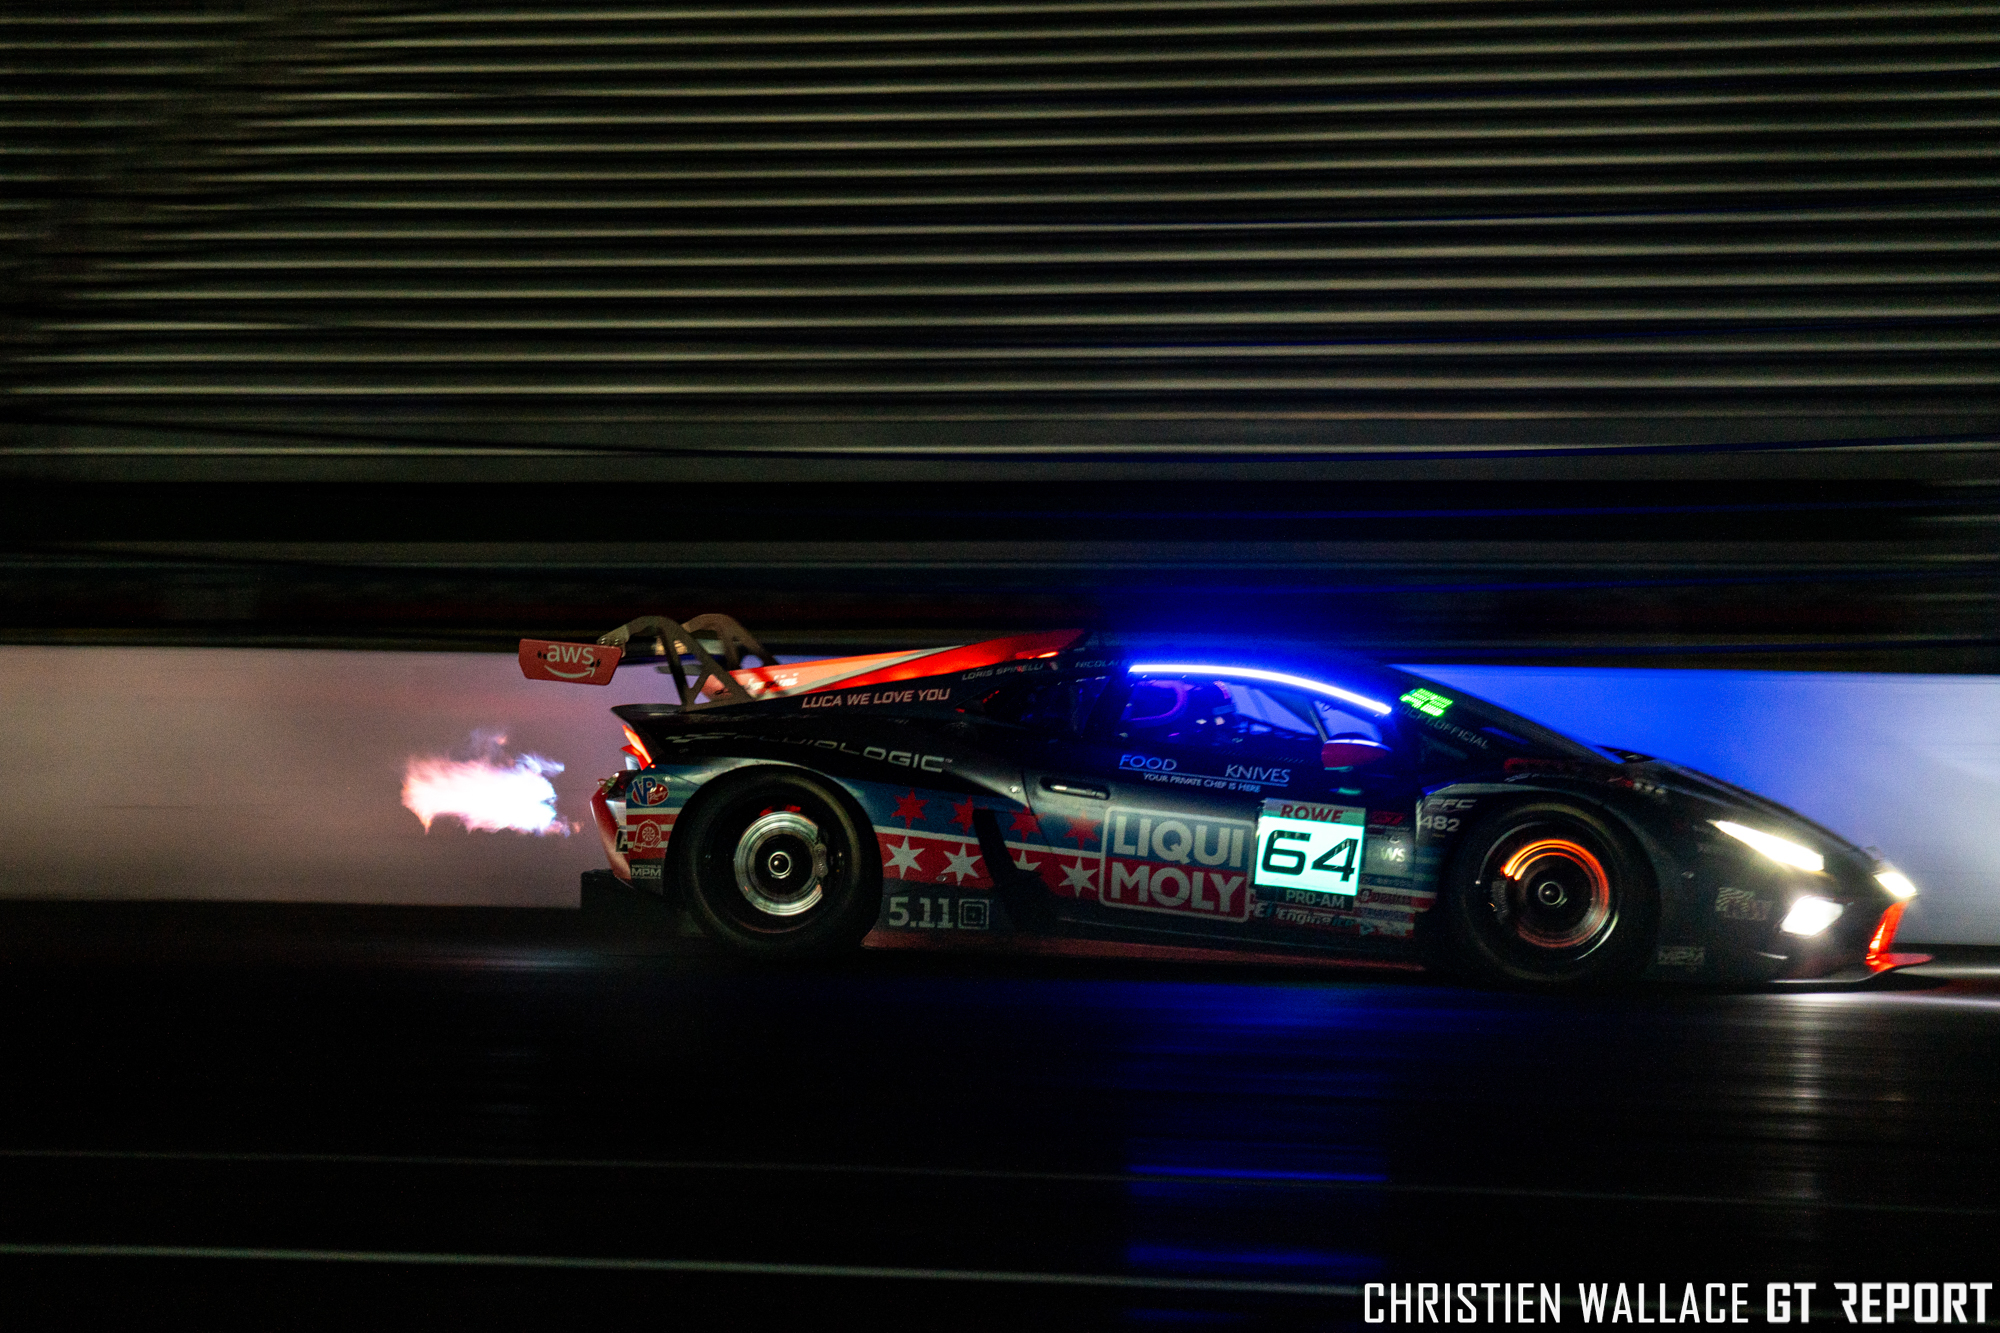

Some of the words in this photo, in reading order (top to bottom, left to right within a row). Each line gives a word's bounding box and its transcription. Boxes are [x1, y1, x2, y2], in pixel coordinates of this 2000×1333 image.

[547, 644, 594, 665] aws
[962, 668, 993, 681] LORIS
[801, 694, 842, 709] LUCA
[846, 692, 872, 706] WE
[873, 689, 915, 704] LOVE
[917, 688, 951, 701] YOU
[1119, 754, 1177, 771] FOOD
[1225, 764, 1291, 783] KNIVES
[632, 775, 656, 806] VP
[1143, 773, 1168, 784] YOUR
[1169, 774, 1202, 787] PRIVATE
[1238, 783, 1261, 793] HERE
[1281, 804, 1343, 823] ROWE
[1420, 815, 1461, 832] 482
[1113, 815, 1245, 868] LIQUI
[1261, 829, 1359, 882] 64
[632, 868, 661, 877] MPM
[1110, 861, 1245, 913] MOLY
[1286, 889, 1345, 909] PRO-AM
[888, 896, 954, 929] 5.11
